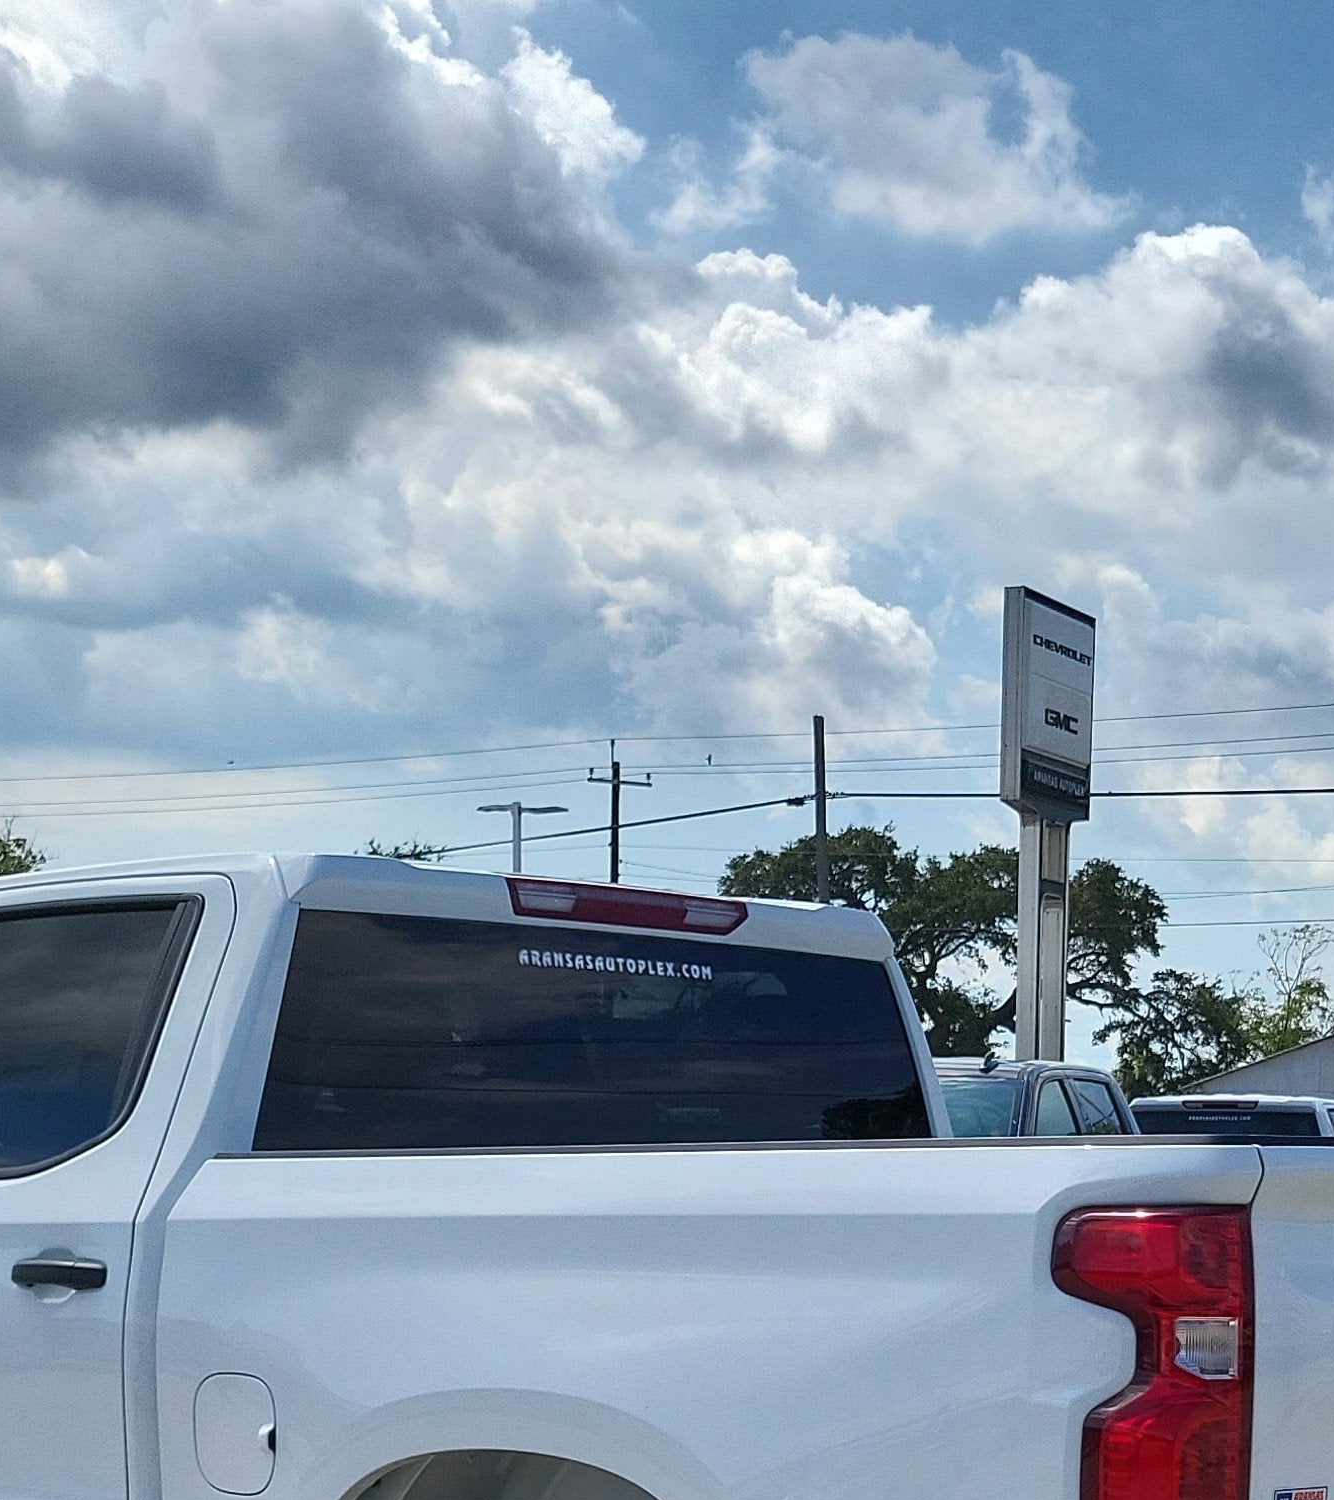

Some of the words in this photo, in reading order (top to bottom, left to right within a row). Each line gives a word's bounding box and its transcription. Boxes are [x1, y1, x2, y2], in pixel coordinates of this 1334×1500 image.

[1032, 633, 1093, 667] CHEVROLET
[1044, 707, 1079, 735] GMC
[518, 948, 713, 981] ARANSASAUTOPLEX.COM
